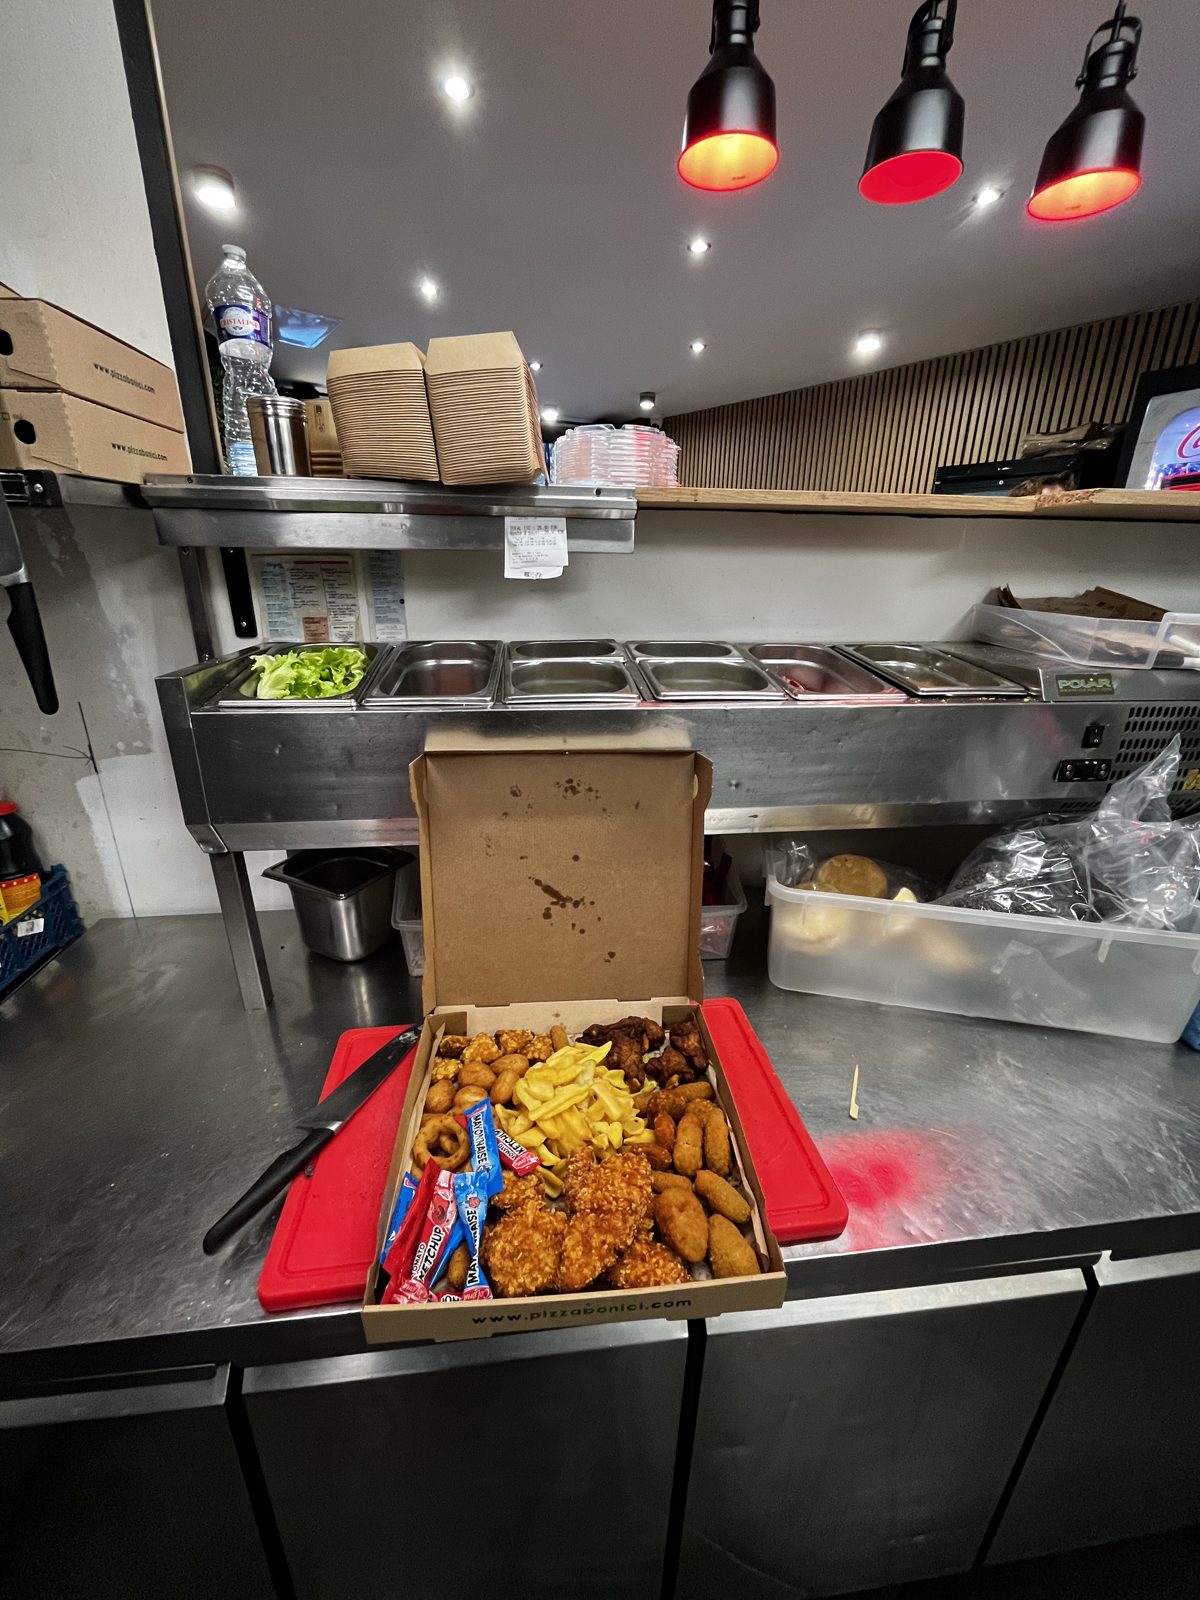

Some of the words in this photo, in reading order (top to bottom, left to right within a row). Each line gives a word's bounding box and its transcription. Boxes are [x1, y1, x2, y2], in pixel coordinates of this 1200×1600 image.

[473, 1113, 488, 1164] MAYONNAISE
[418, 1226, 445, 1281] KETCHUP
[472, 1300, 691, 1324] www.pizzabonici.com
